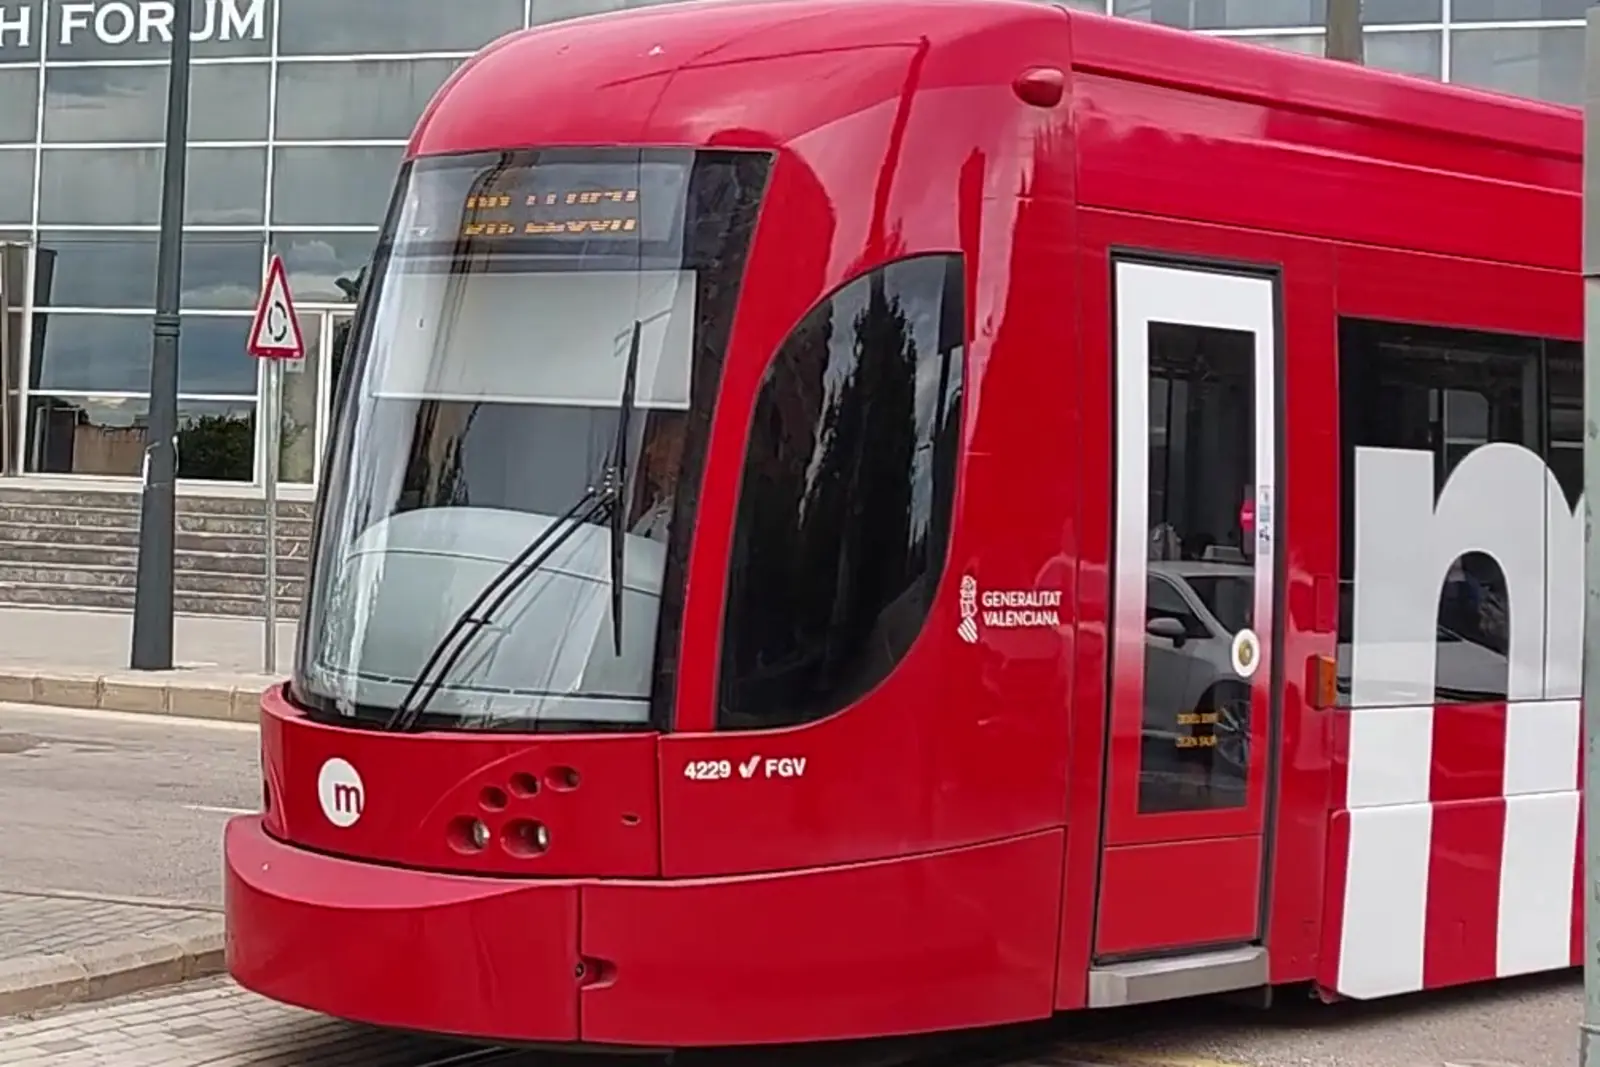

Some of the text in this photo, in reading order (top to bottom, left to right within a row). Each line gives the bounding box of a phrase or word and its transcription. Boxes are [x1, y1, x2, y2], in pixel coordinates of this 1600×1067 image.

[982, 591, 1062, 607] GENERALITAT
[983, 611, 1060, 626] VALENCIANA
[684, 757, 806, 780] 4229 FGV
